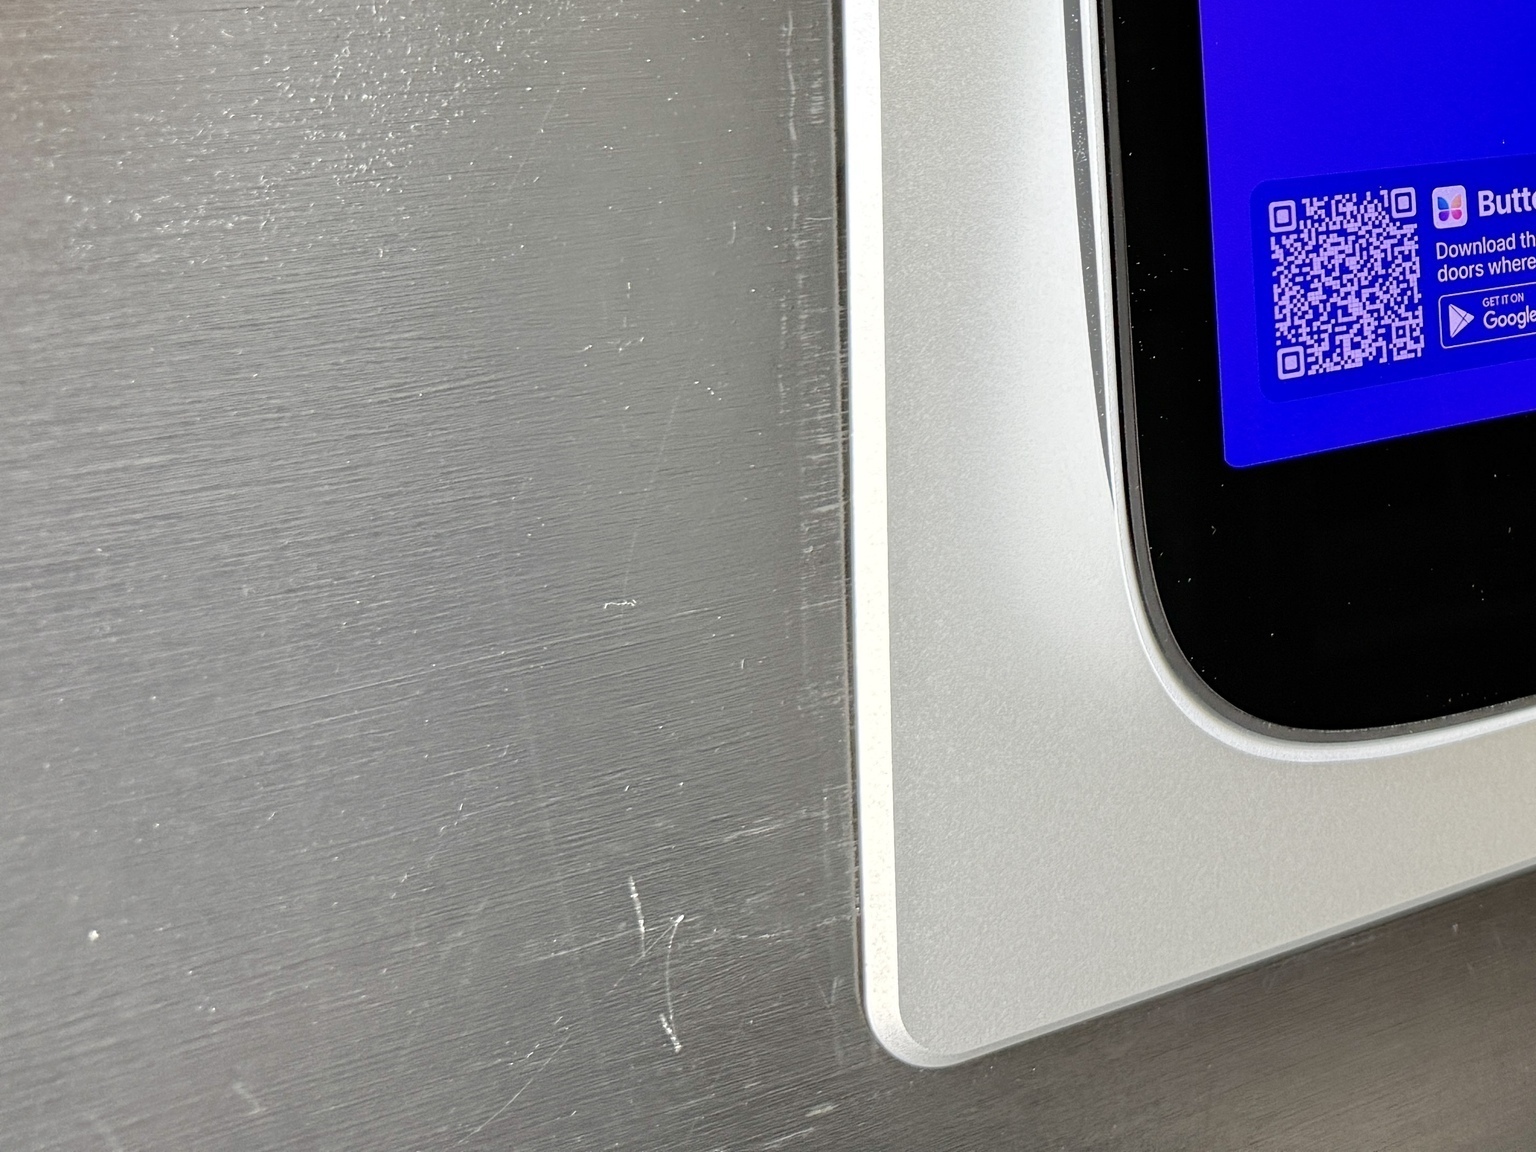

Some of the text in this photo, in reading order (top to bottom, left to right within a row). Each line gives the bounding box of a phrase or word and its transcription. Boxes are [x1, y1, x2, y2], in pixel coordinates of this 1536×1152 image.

[1436, 232, 1516, 260] Download
[1437, 264, 1484, 282] doors
[1488, 256, 1536, 275] where
[1482, 292, 1524, 307] GET IT ON
